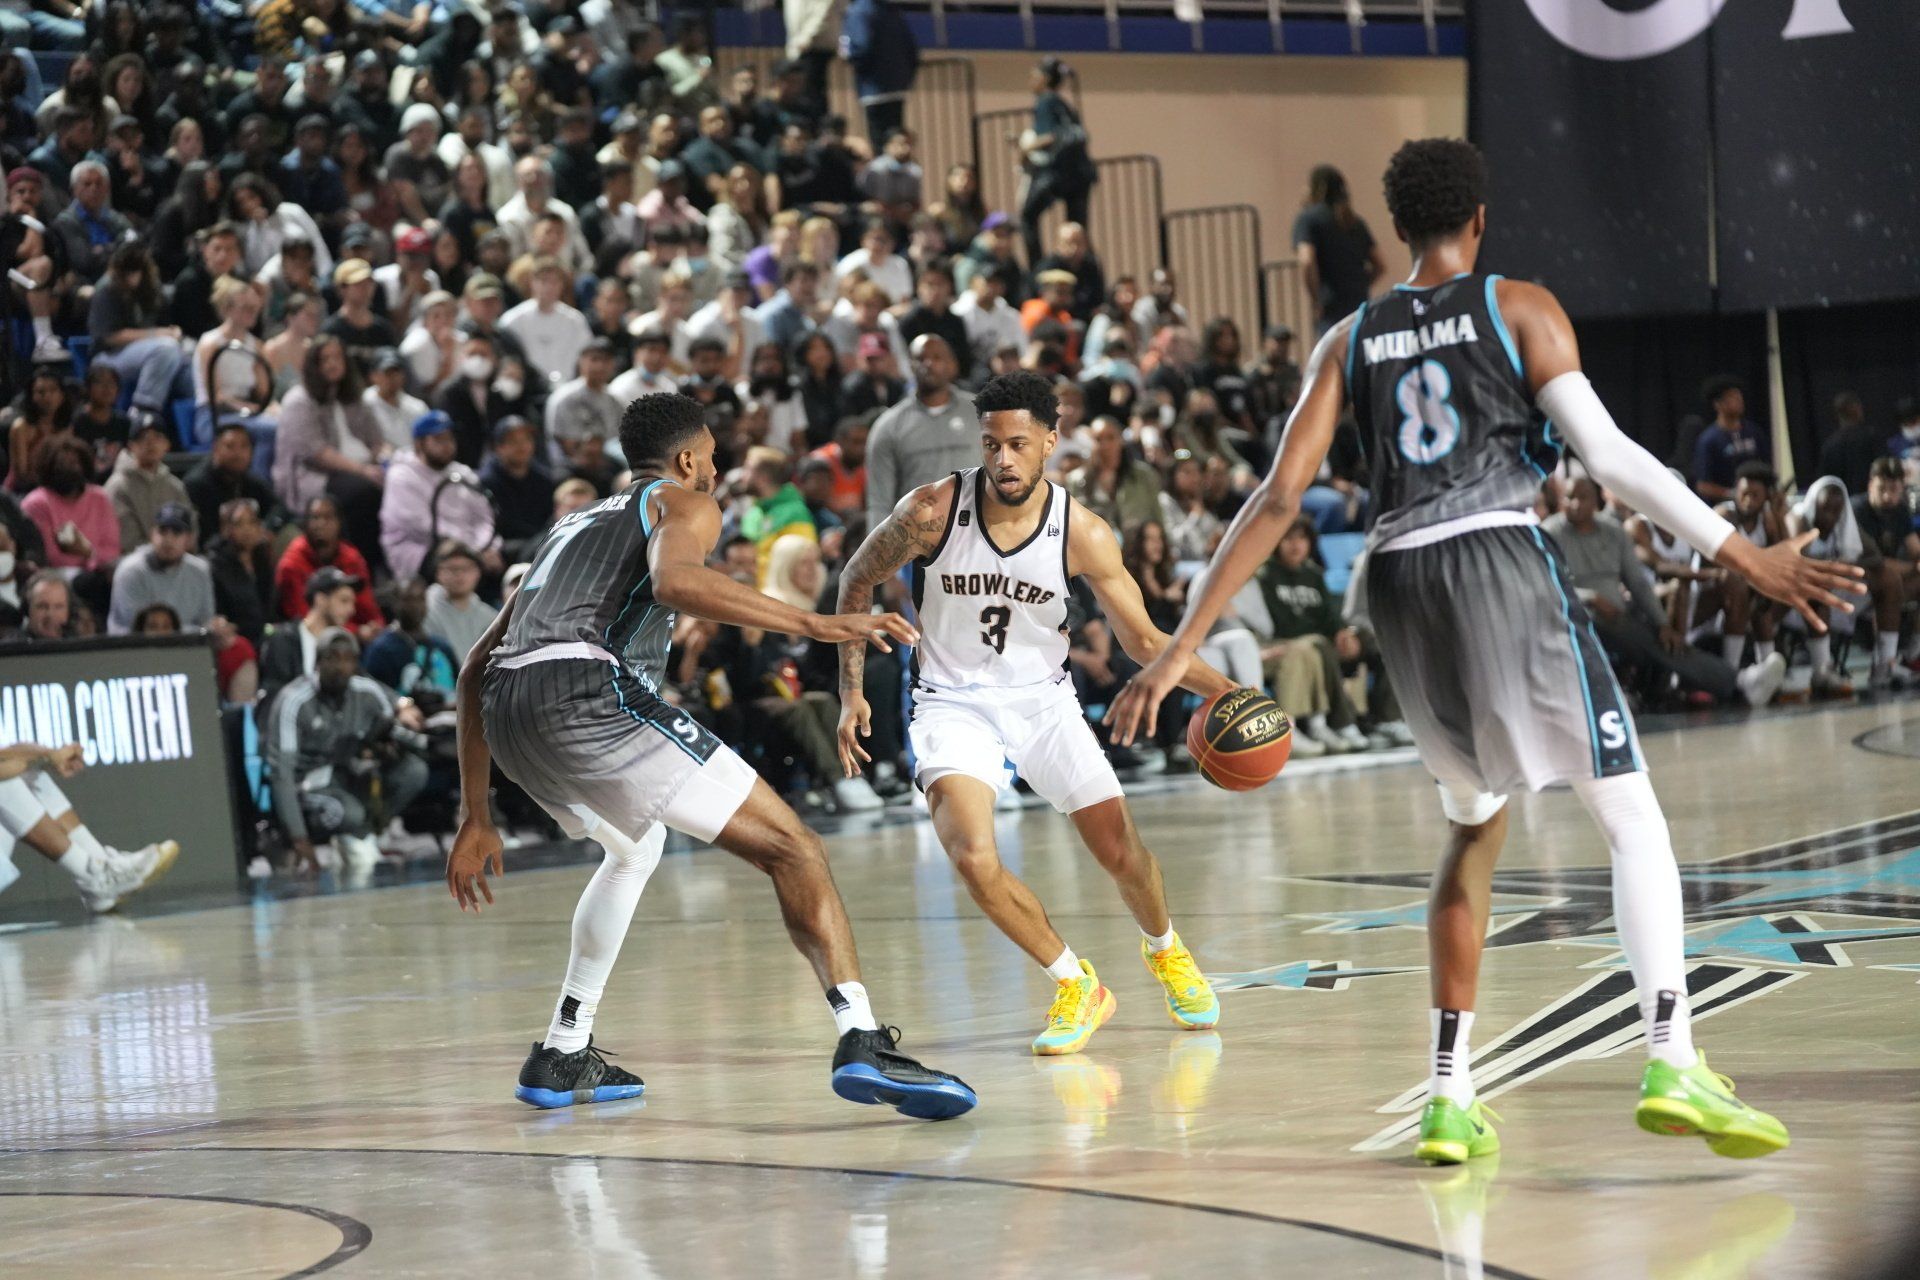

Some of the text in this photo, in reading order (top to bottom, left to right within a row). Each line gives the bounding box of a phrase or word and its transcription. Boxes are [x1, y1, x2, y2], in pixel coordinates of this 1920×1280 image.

[1396, 358, 1460, 465] 8
[941, 573, 1055, 605] GROWLERS
[979, 605, 1012, 655] 3
[75, 673, 193, 767] CONTENT
